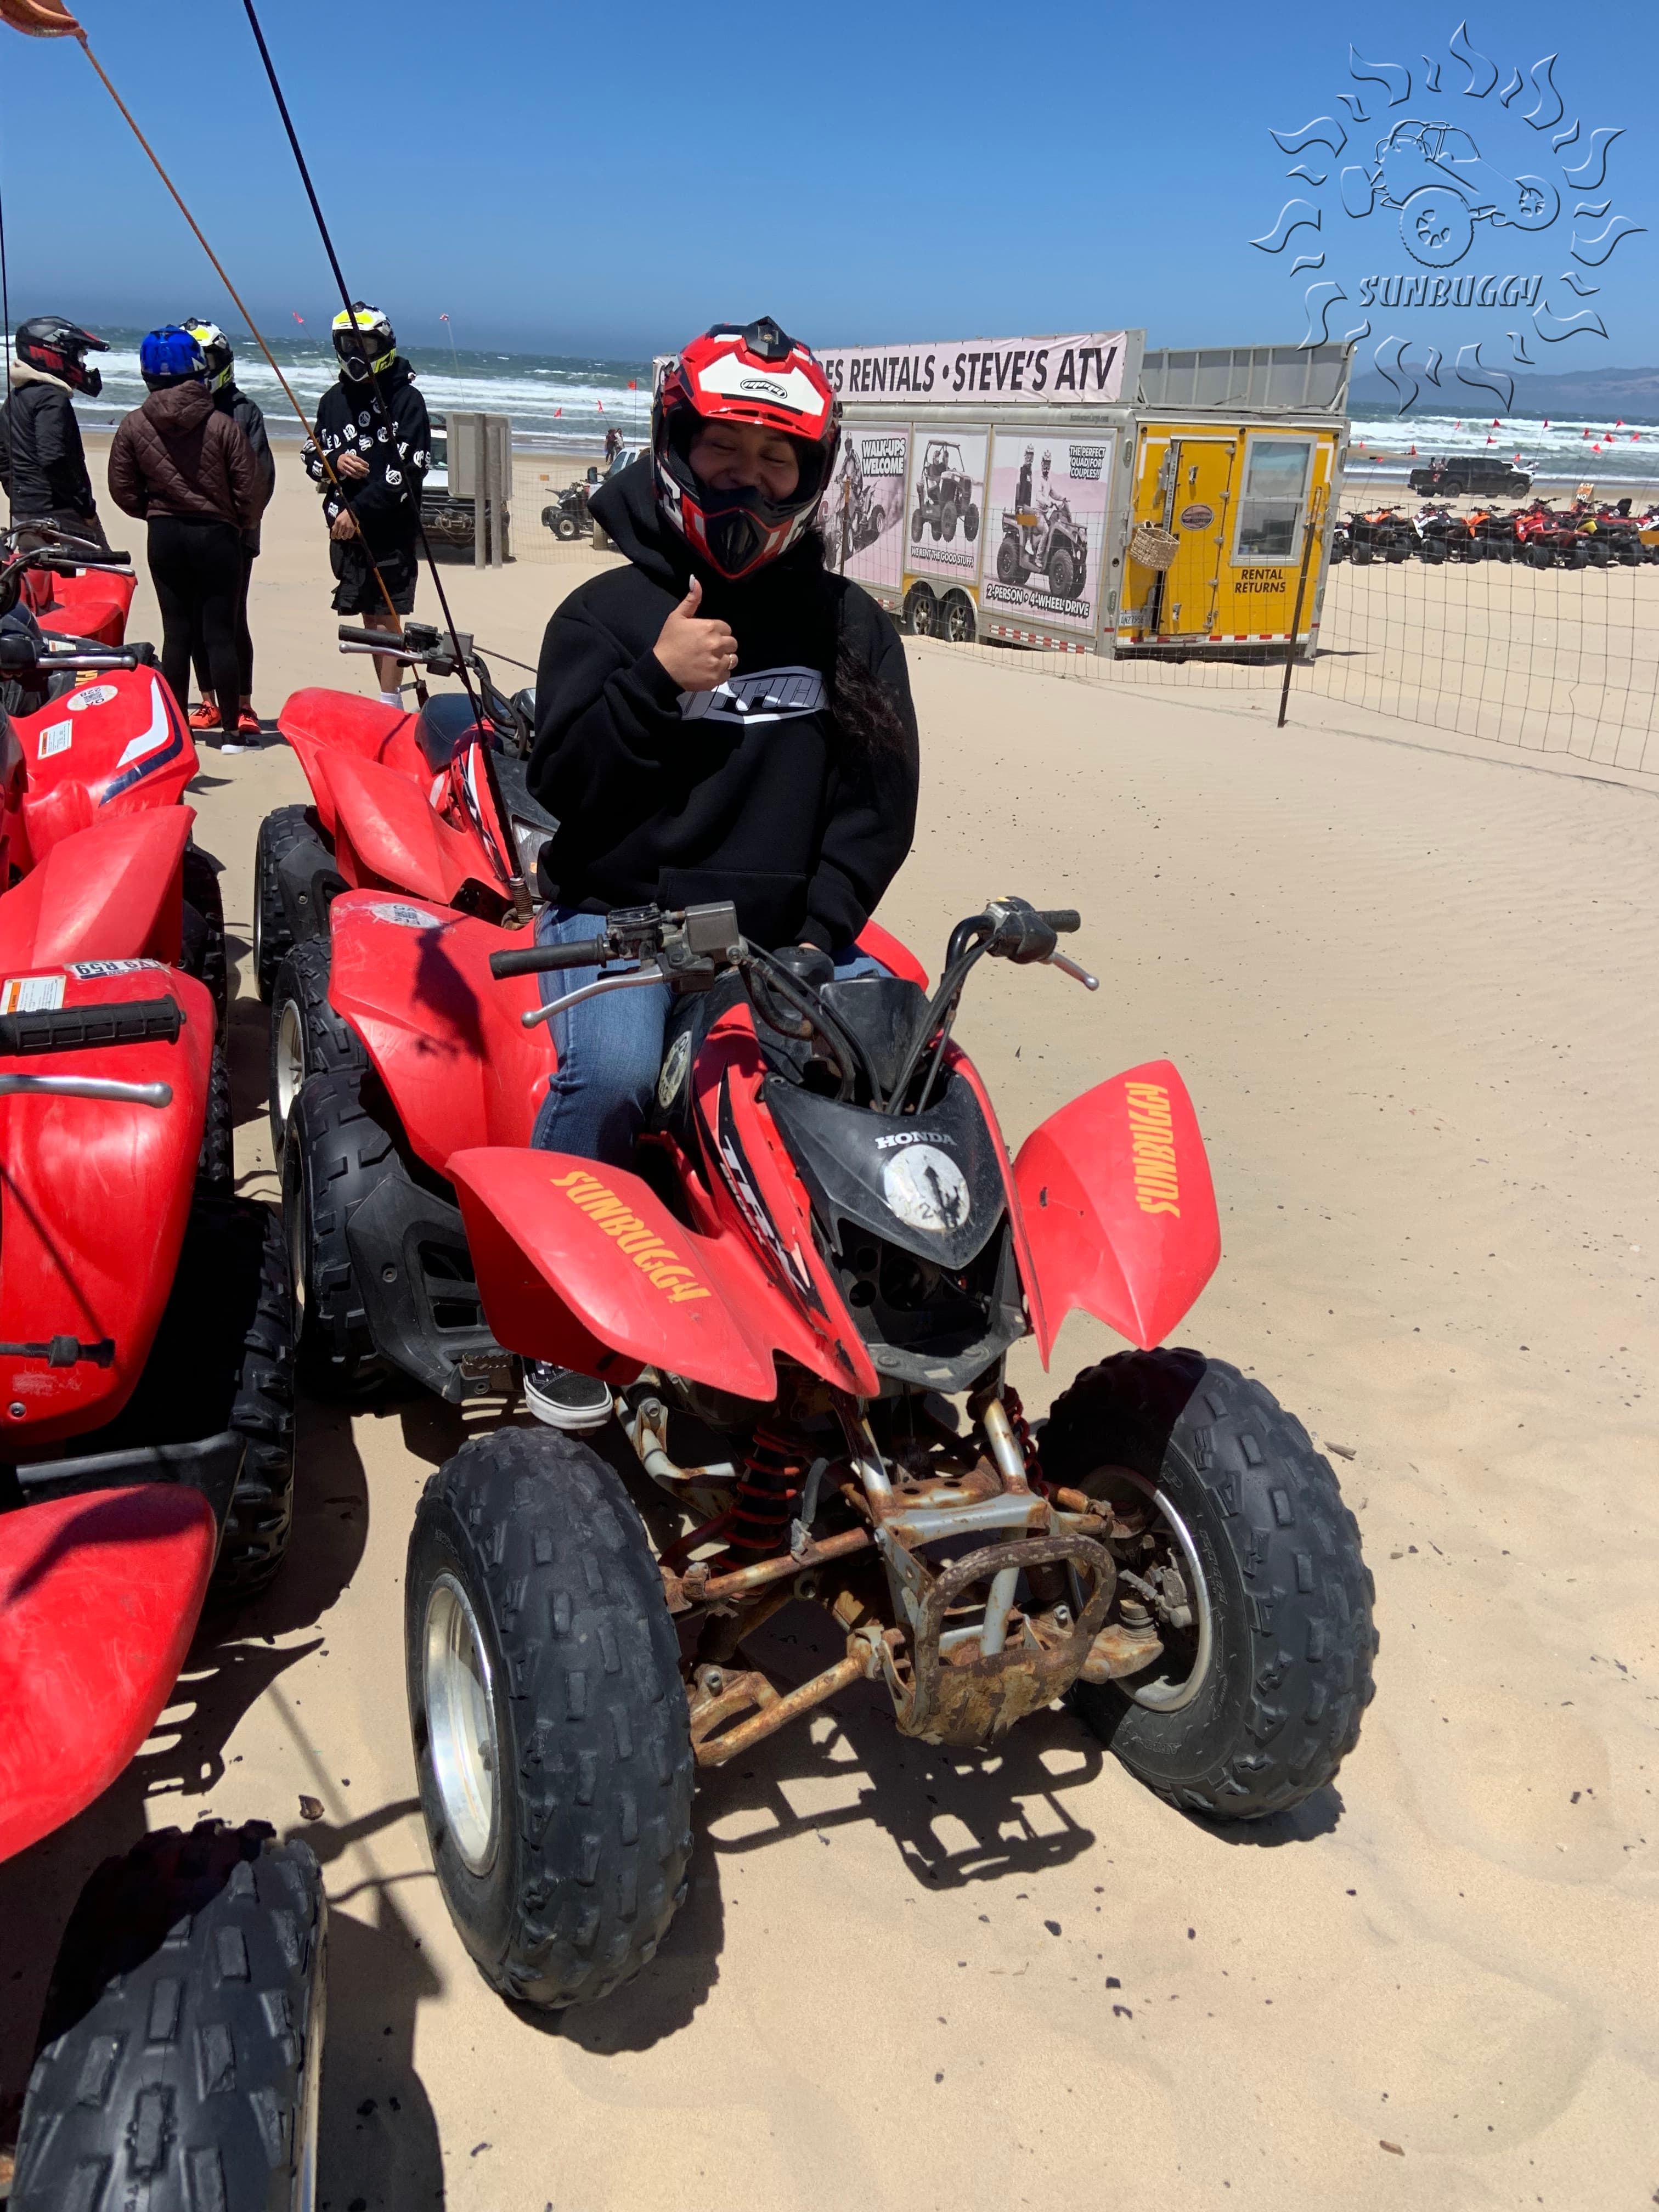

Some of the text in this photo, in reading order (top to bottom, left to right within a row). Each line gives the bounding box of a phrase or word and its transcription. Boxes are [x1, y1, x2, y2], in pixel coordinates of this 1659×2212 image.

[817, 359, 844, 393] ES
[849, 354, 936, 392] RENTALS
[952, 349, 1049, 392] STEVE'S
[1054, 346, 1118, 391] ATV
[862, 438, 905, 458] WALK-UPS
[1069, 445, 1106, 458] THE PERFECT
[862, 456, 904, 476] WELCOME
[1070, 457, 1103, 469] QUAD FOR
[1070, 467, 1101, 480] COUPLES!!
[911, 546, 974, 567] WE RENT THE GOOD STUFF!
[1241, 569, 1283, 580] RENTAL
[1234, 582, 1286, 593] RETURNS
[986, 584, 1090, 618] 2-PERSON 4-WHEEL DRIVE
[75, 962, 119, 975] R59
[874, 1131, 957, 1149] HONDA
[1125, 1082, 1181, 1218] SUNBUGGY
[549, 1171, 712, 1304] SUNBUGGY
